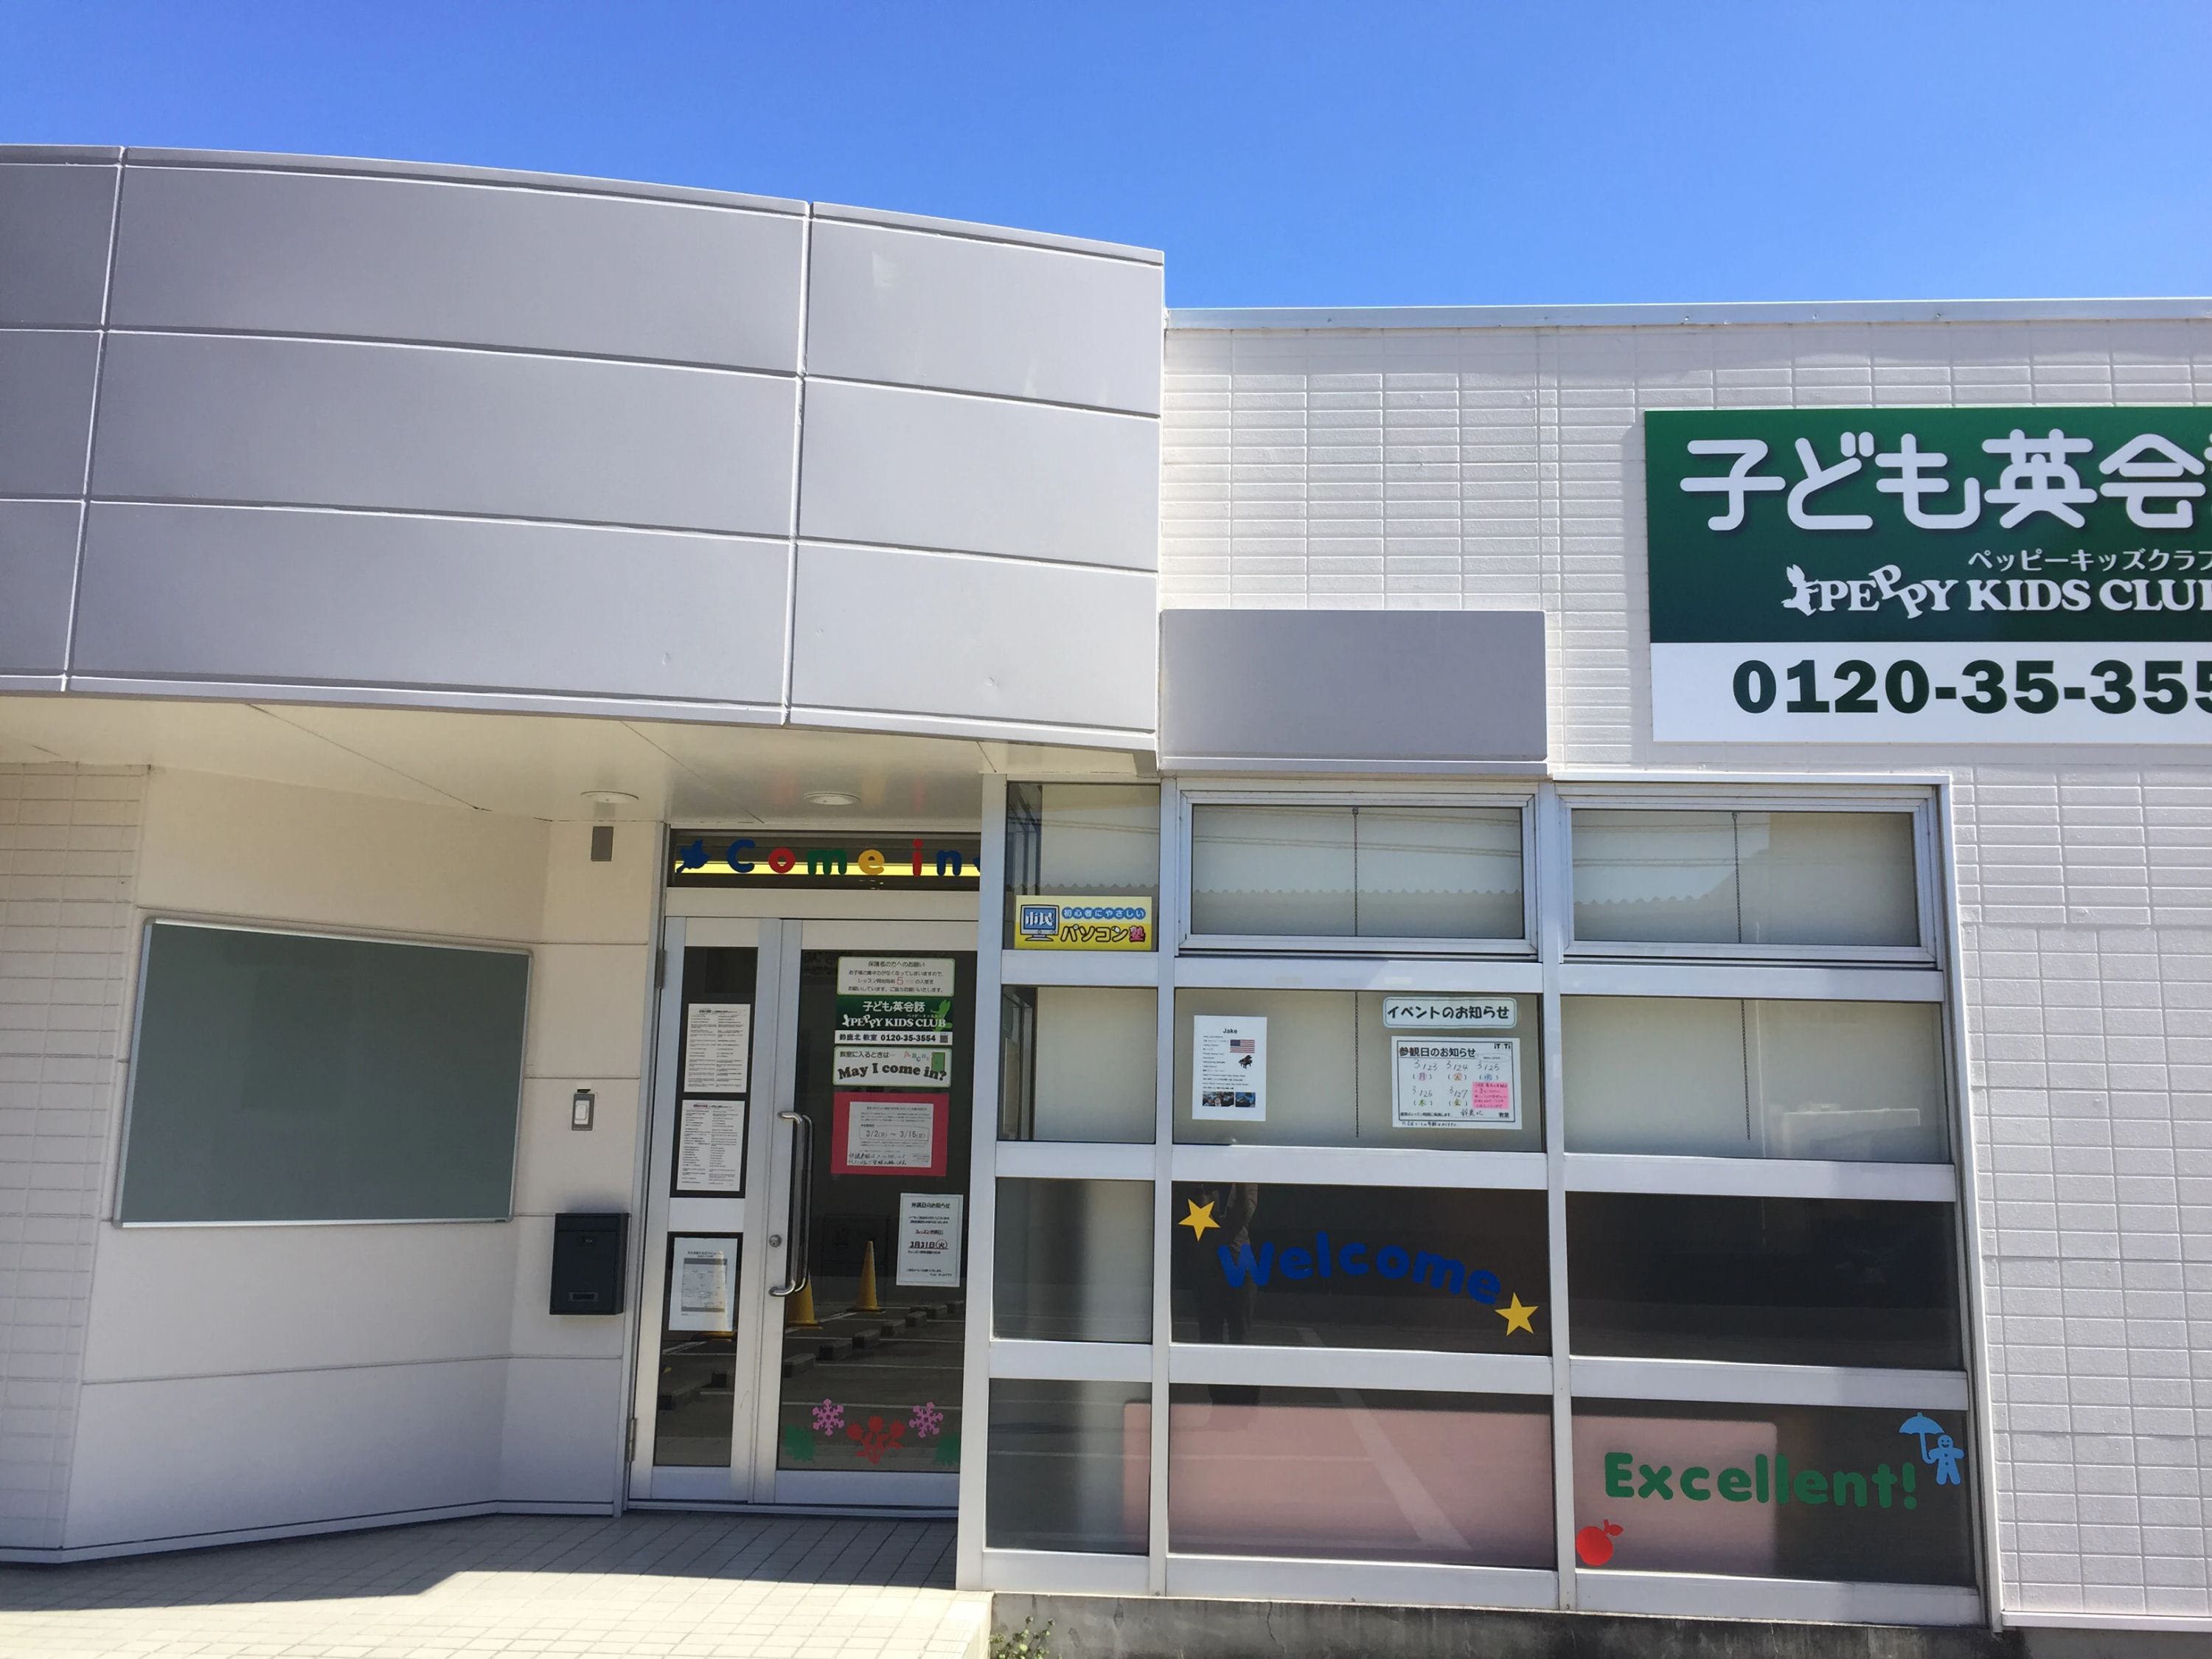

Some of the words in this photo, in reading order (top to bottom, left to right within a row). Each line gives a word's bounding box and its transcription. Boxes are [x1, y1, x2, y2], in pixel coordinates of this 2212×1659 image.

[1680, 428, 2212, 531] 子ども英会
[1818, 564, 1959, 619] PEPPY
[1966, 579, 2091, 611] KIDS
[727, 839, 885, 876] Come
[913, 838, 962, 877] in
[1026, 911, 1053, 926] 市民
[1063, 908, 1144, 919] 初心者にやさしい
[1060, 924, 1145, 942] パソコン塾
[863, 1001, 925, 1012] 子ども英会話
[1388, 1006, 1509, 1019] イベントのお知らせ
[849, 1015, 883, 1029] PEPPY
[885, 1018, 914, 1027] KIDS
[915, 1018, 946, 1027] CLUB
[880, 1034, 936, 1043] 0120-35-3554
[1399, 1047, 1475, 1057] 参観日のお知らせ
[838, 1065, 869, 1079] May
[872, 1063, 878, 1073] I
[882, 1064, 920, 1076] come
[924, 1066, 947, 1081] in?
[1217, 1231, 1501, 1305] Welcome
[1604, 1452, 1916, 1509] Excellent!
